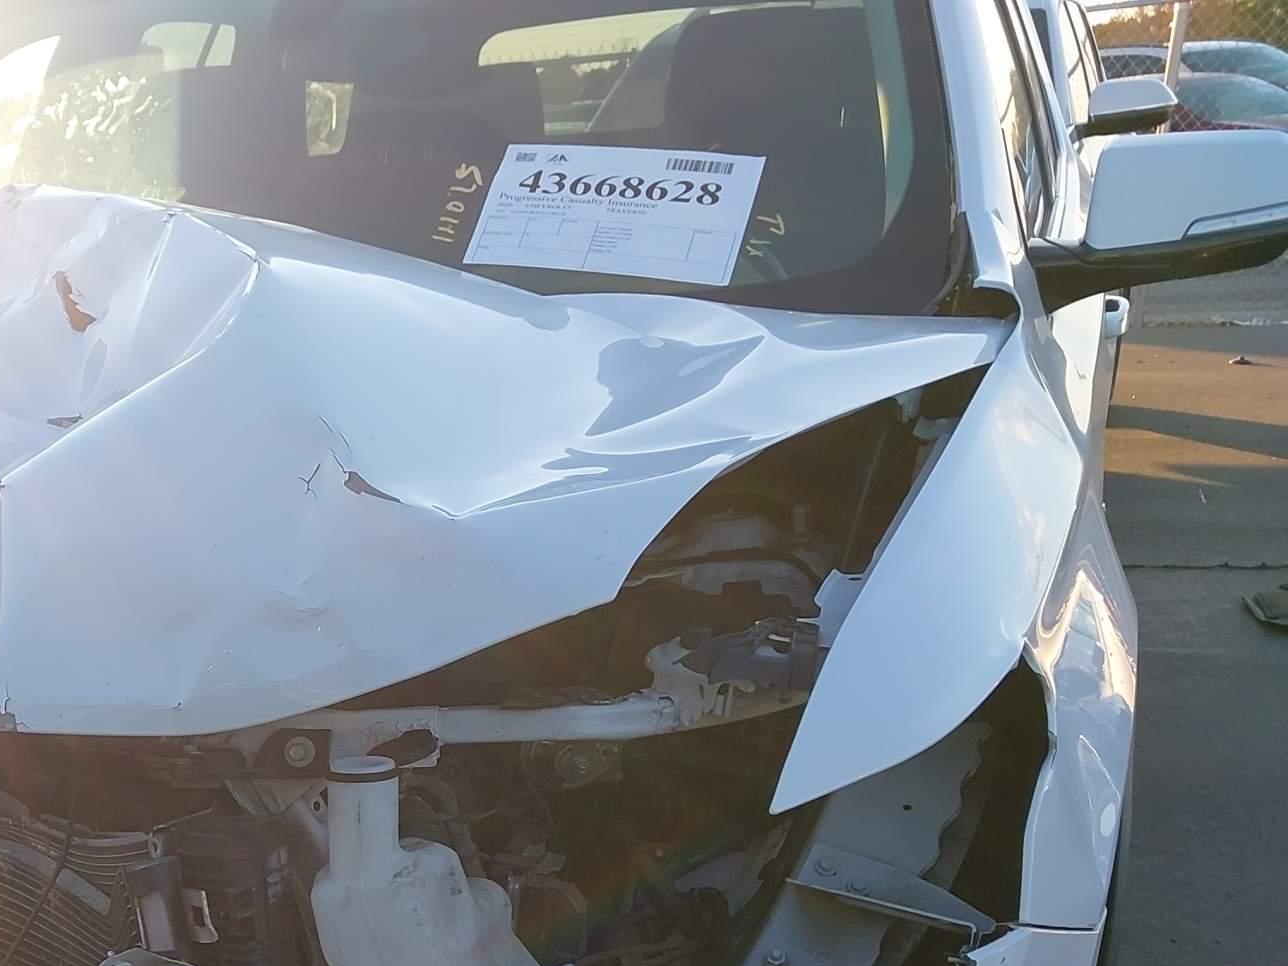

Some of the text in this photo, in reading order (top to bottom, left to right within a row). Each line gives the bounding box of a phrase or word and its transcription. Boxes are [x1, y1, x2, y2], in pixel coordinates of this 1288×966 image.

[499, 192, 658, 208] Progressive Casualty Insurance
[518, 169, 723, 206] 43668628
